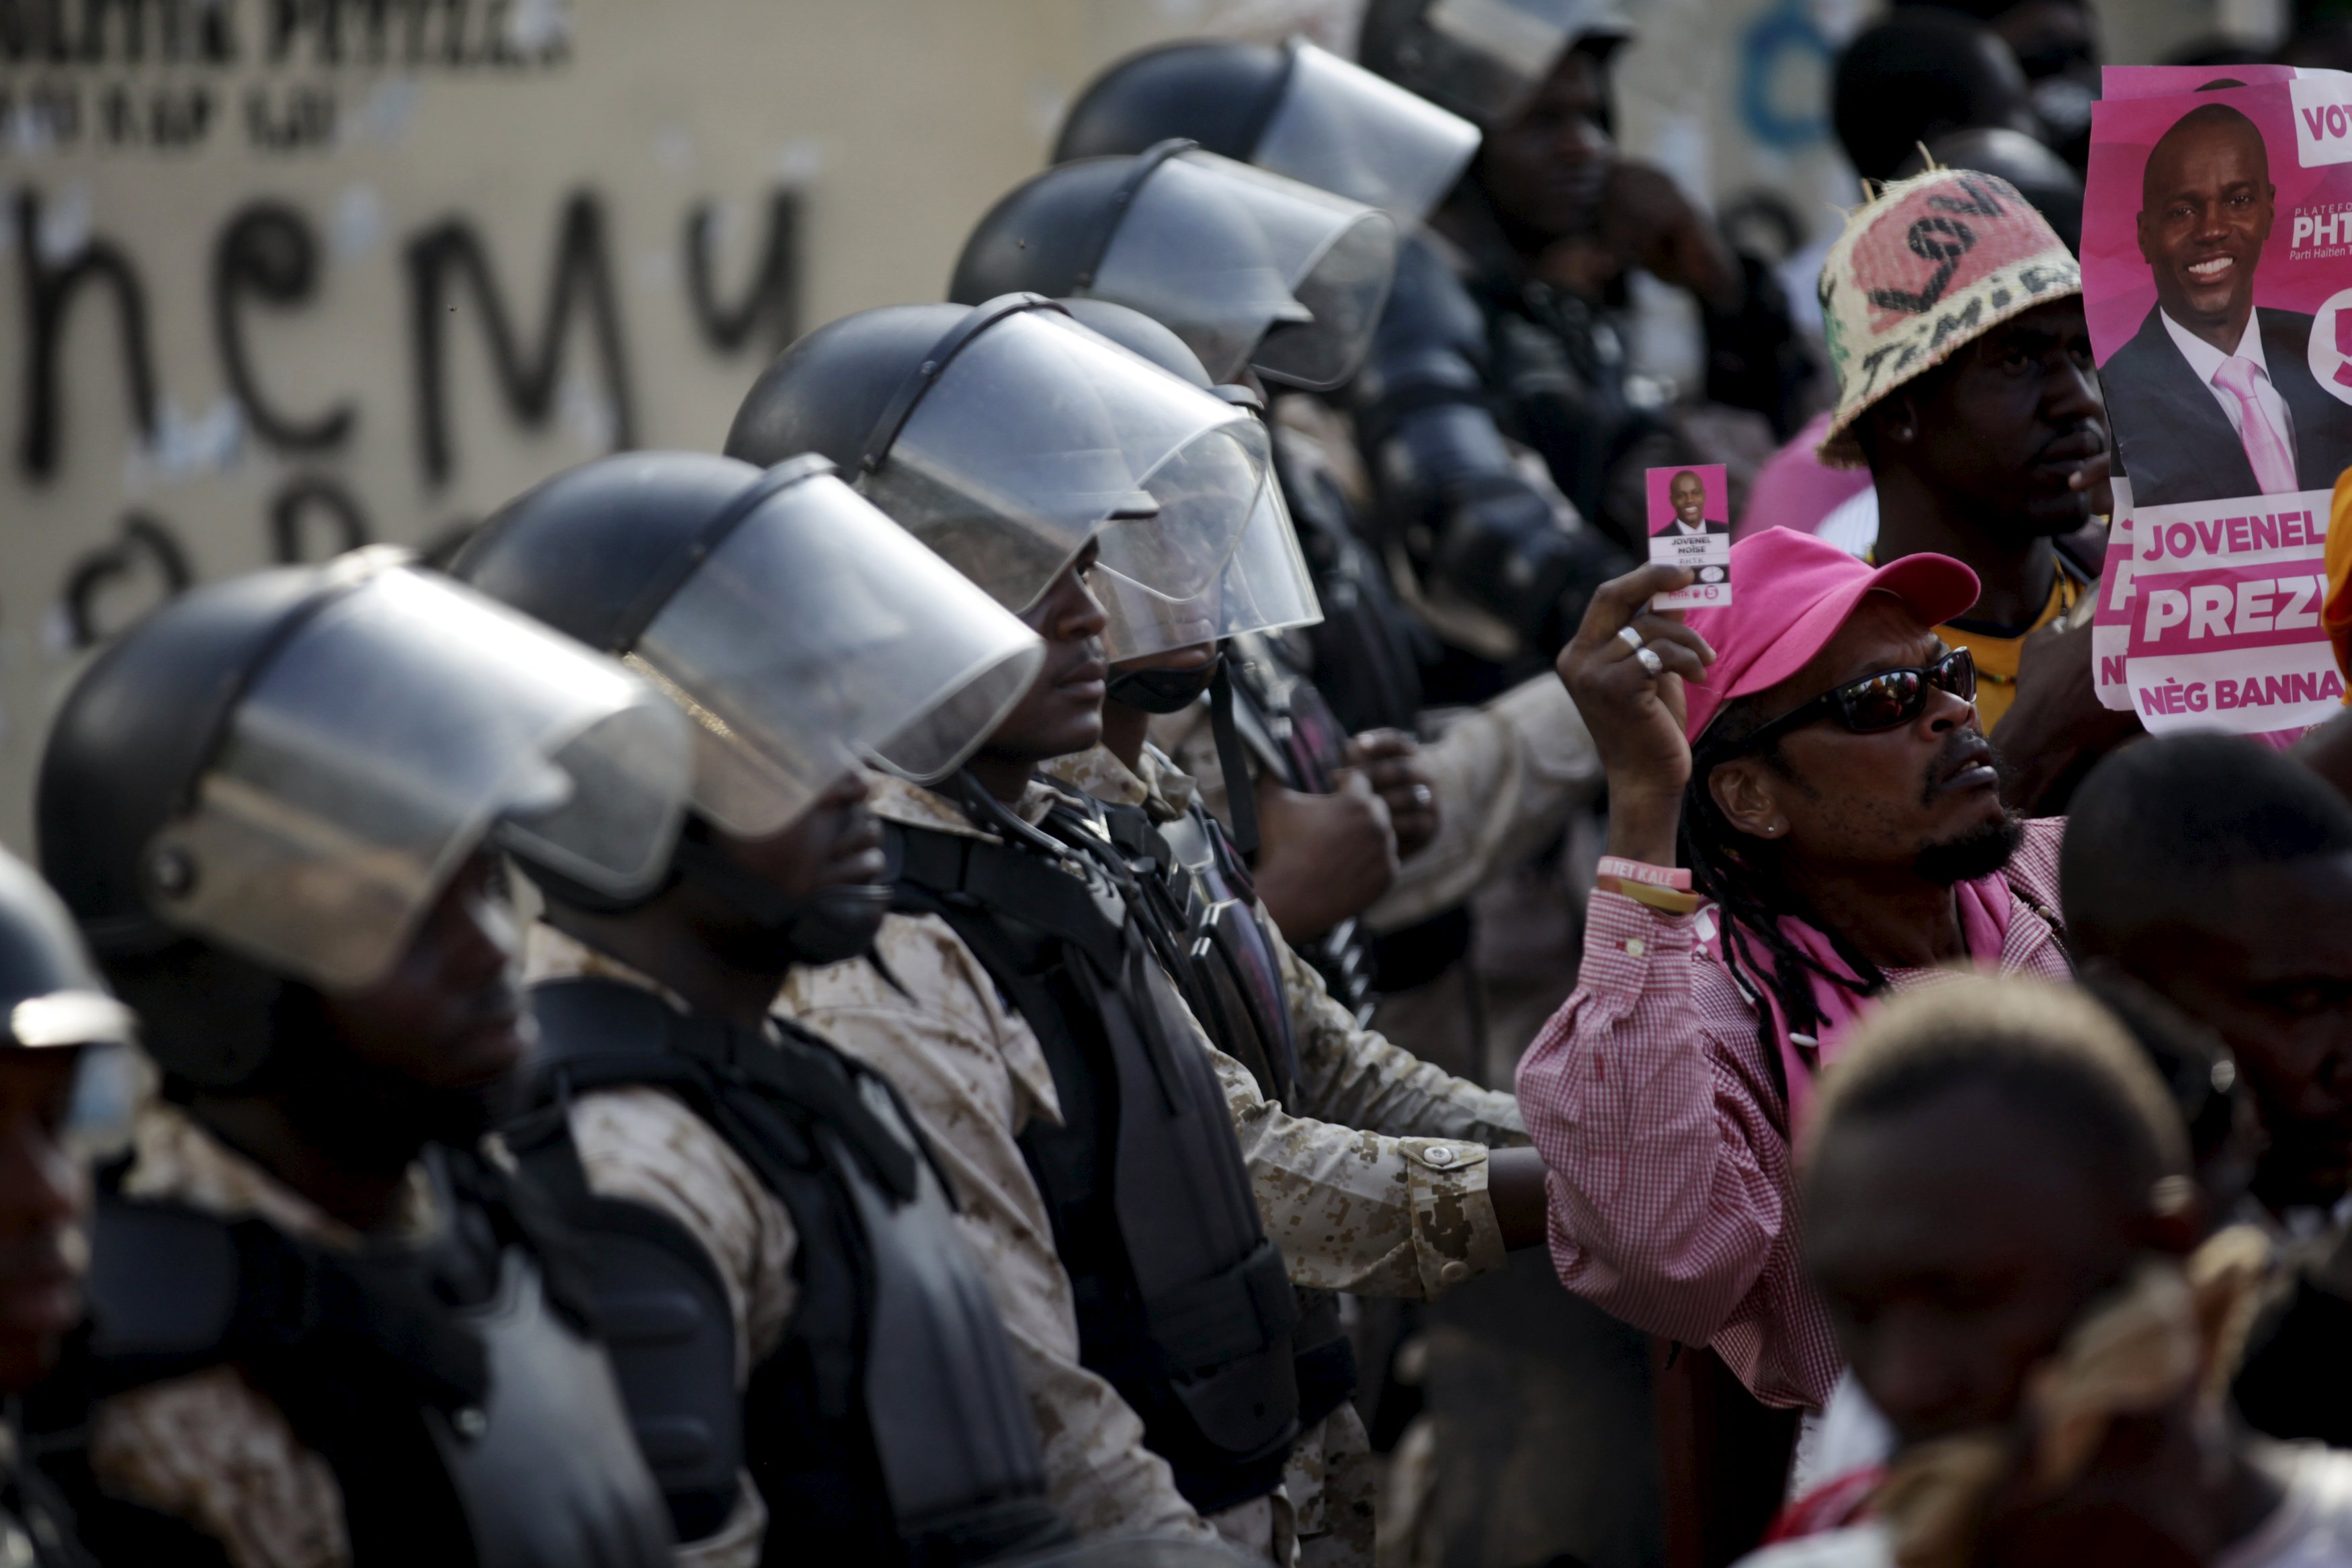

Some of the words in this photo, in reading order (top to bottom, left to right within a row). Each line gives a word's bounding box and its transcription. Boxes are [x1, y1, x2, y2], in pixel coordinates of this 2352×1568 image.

[2290, 249, 2312, 261] Parti
[1672, 537, 1712, 546] JOVENEL
[2142, 510, 2326, 562] JOVENEL
[2140, 677, 2209, 715] NÈG
[1637, 867, 1675, 886] KALE
